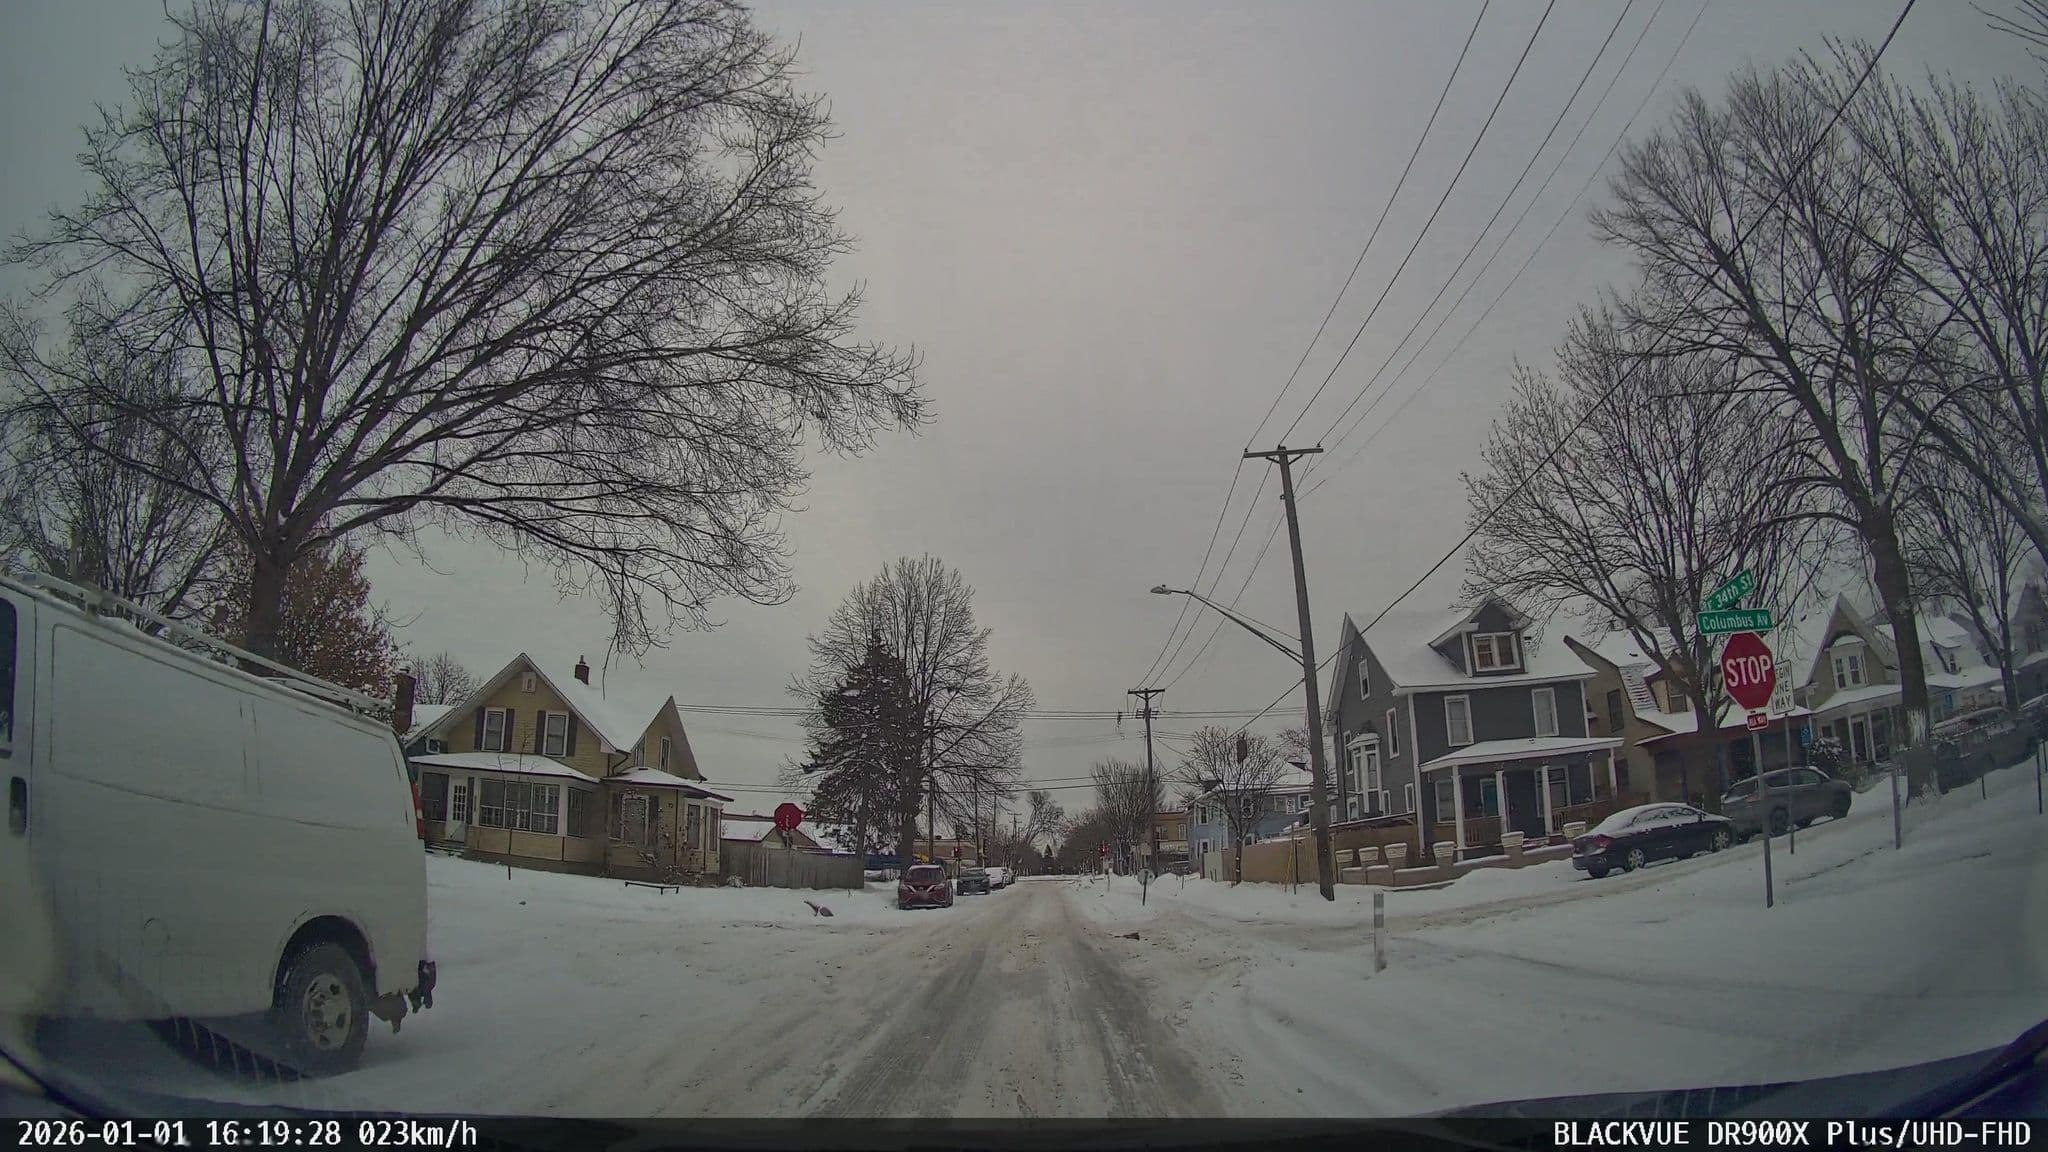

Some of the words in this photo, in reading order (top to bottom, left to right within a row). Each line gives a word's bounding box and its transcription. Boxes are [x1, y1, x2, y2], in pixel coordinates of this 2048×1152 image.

[1715, 584, 1739, 608] 34th
[1740, 574, 1753, 590] St
[1702, 614, 1754, 631] Columbus
[1756, 614, 1769, 627] Av
[1725, 654, 1772, 688] STOP
[1775, 694, 1791, 710] WAY
